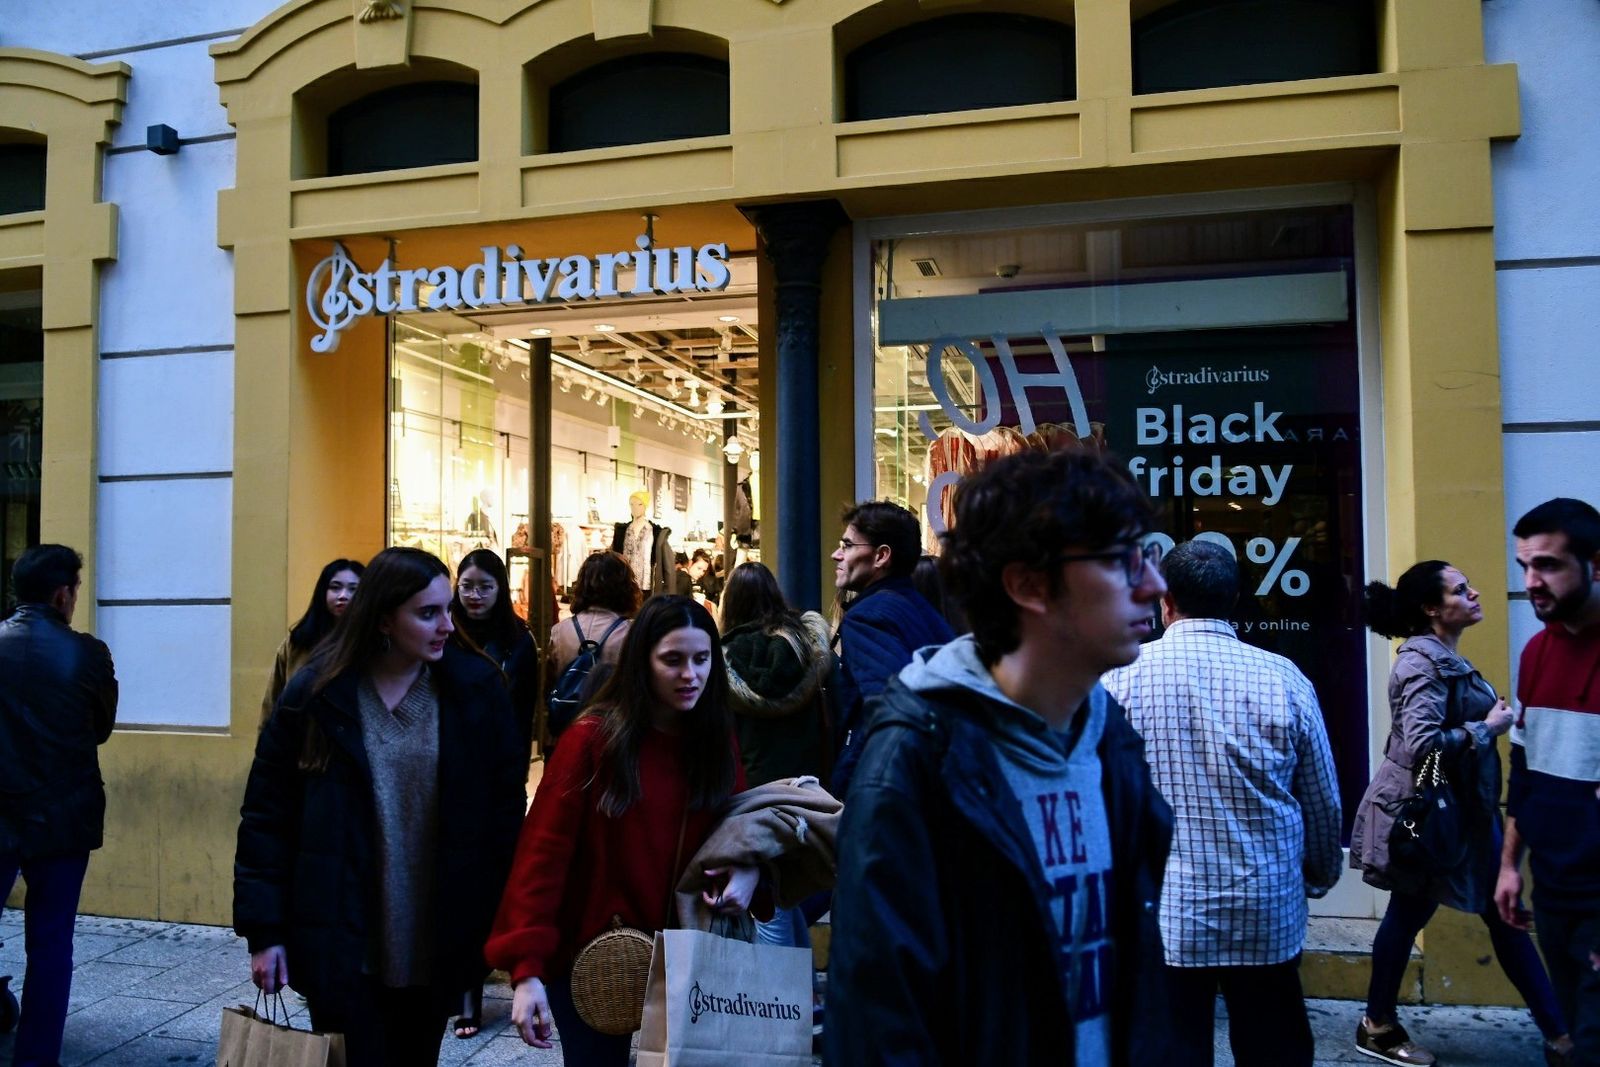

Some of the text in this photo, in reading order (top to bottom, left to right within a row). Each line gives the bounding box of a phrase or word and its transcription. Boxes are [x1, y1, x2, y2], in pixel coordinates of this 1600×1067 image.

[349, 234, 730, 318] stradivarius
[1160, 365, 1270, 387] stradivarius
[1136, 401, 1285, 446] Black
[1128, 454, 1294, 506] friday
[1244, 621, 1253, 633] y
[1259, 617, 1310, 631] online
[702, 992, 801, 1021] stradivarius
